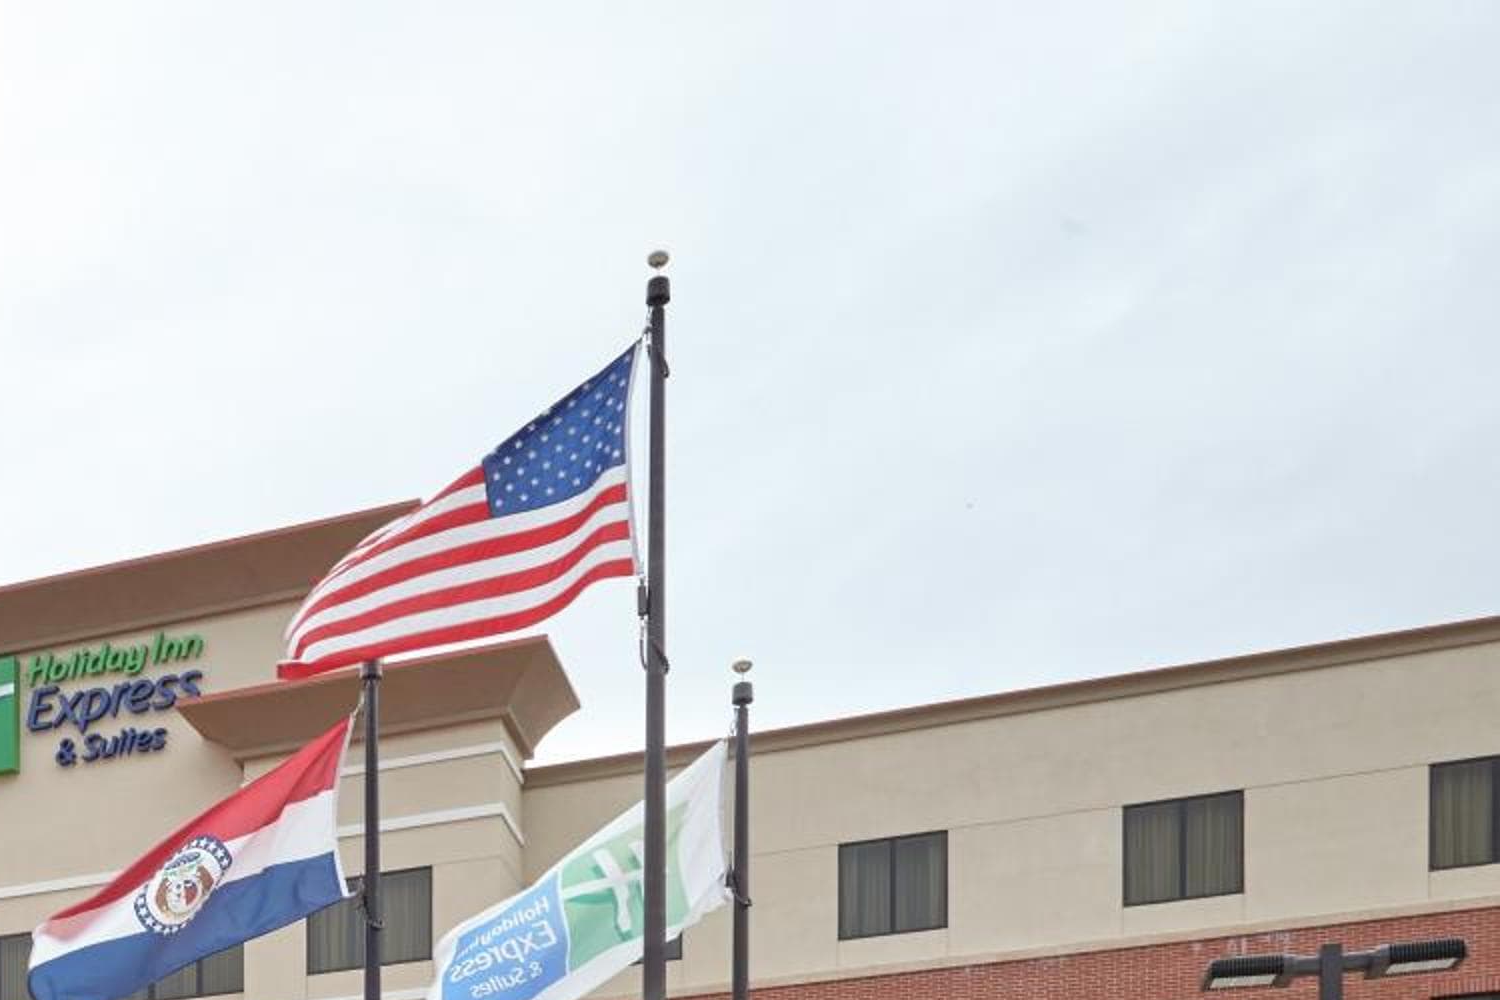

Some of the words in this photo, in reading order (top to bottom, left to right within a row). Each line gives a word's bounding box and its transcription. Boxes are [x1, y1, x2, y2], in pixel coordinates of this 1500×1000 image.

[28, 643, 148, 687] Holiday
[152, 632, 204, 665] Inn
[27, 670, 203, 735] Express
[56, 738, 77, 767] &
[82, 727, 168, 763] Suites
